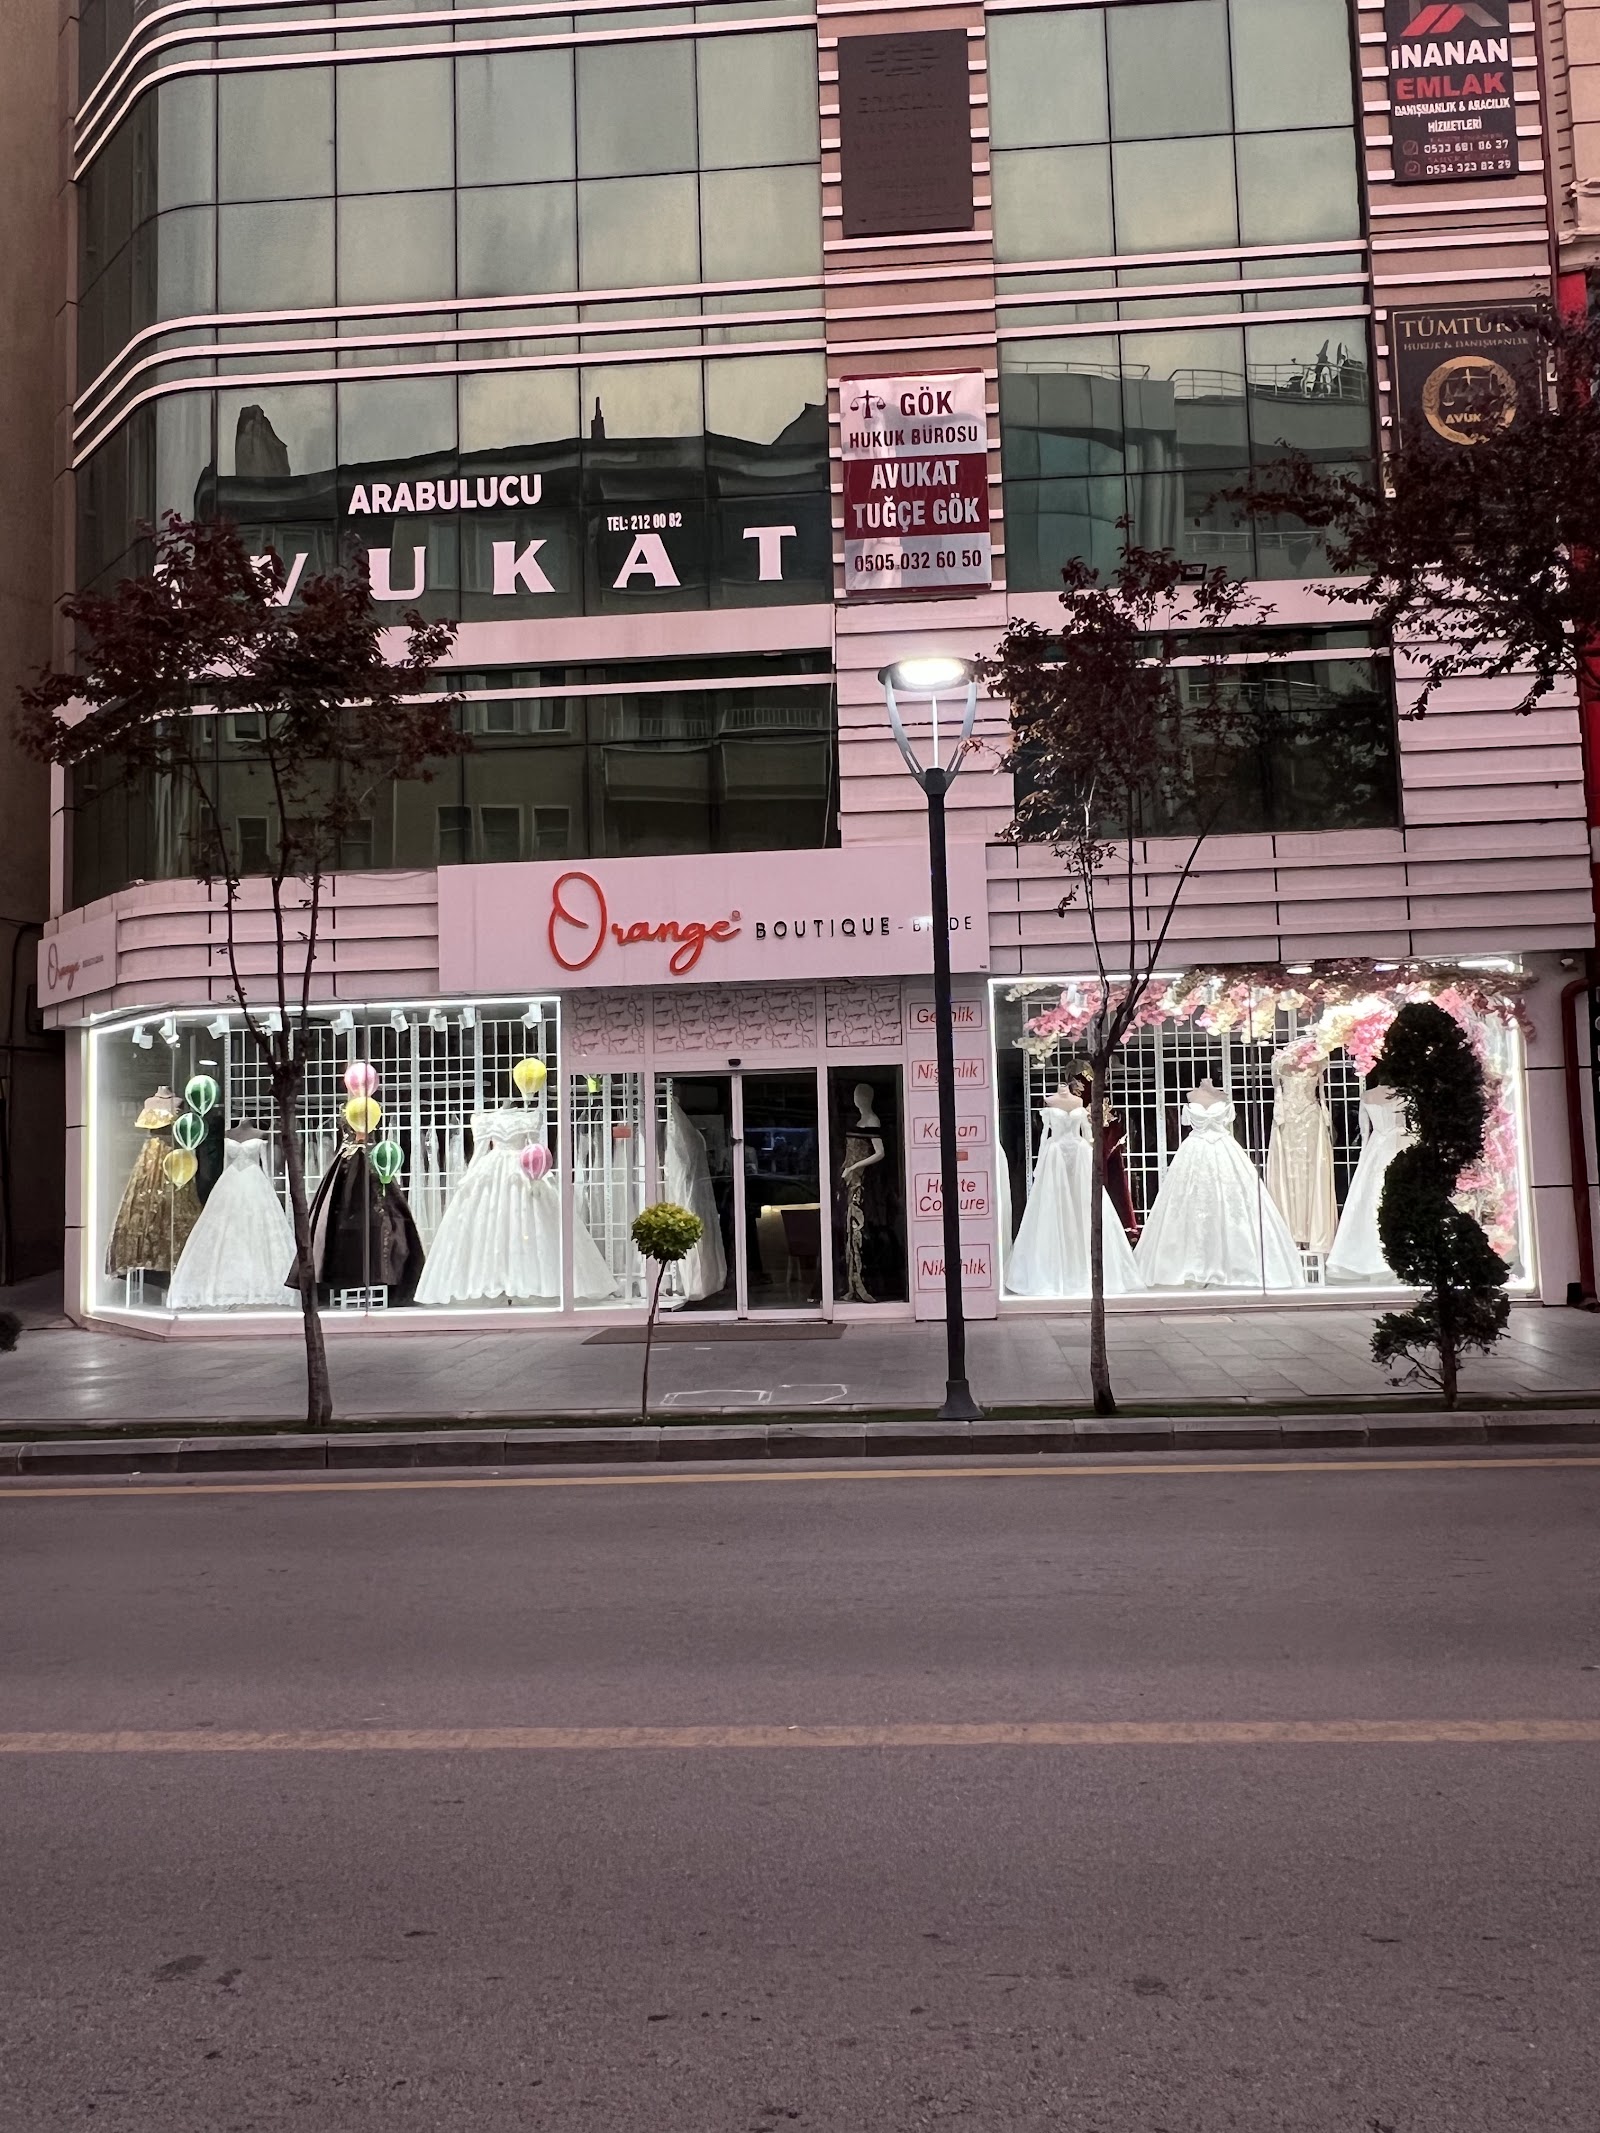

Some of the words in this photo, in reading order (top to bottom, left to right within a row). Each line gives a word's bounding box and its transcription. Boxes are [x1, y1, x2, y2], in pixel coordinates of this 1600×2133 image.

[1396, 72, 1506, 99] EMLAK
[1468, 97, 1510, 111] ARACILIK
[1428, 116, 1482, 132] HİZMETLERİ
[1496, 139, 1508, 148] 37
[1427, 164, 1453, 174] 0534
[1457, 162, 1477, 172] 323
[901, 387, 953, 416] GÖK
[850, 430, 905, 448] HUKUK
[911, 425, 978, 445] BÜROSU
[871, 460, 960, 490] AVUKAT
[348, 474, 542, 515] ARABULUCU
[607, 516, 628, 531] TEL:
[631, 514, 650, 530] 212
[853, 495, 925, 533] TUĞÇE
[933, 493, 980, 525] GÖK
[855, 554, 895, 572] 0505
[901, 552, 930, 570] 032
[936, 551, 956, 568] 60
[962, 549, 982, 567] 50
[549, 872, 741, 975] Orange
[756, 917, 890, 940] BOUTIQUE
[919, 1196, 985, 1212] Coure
